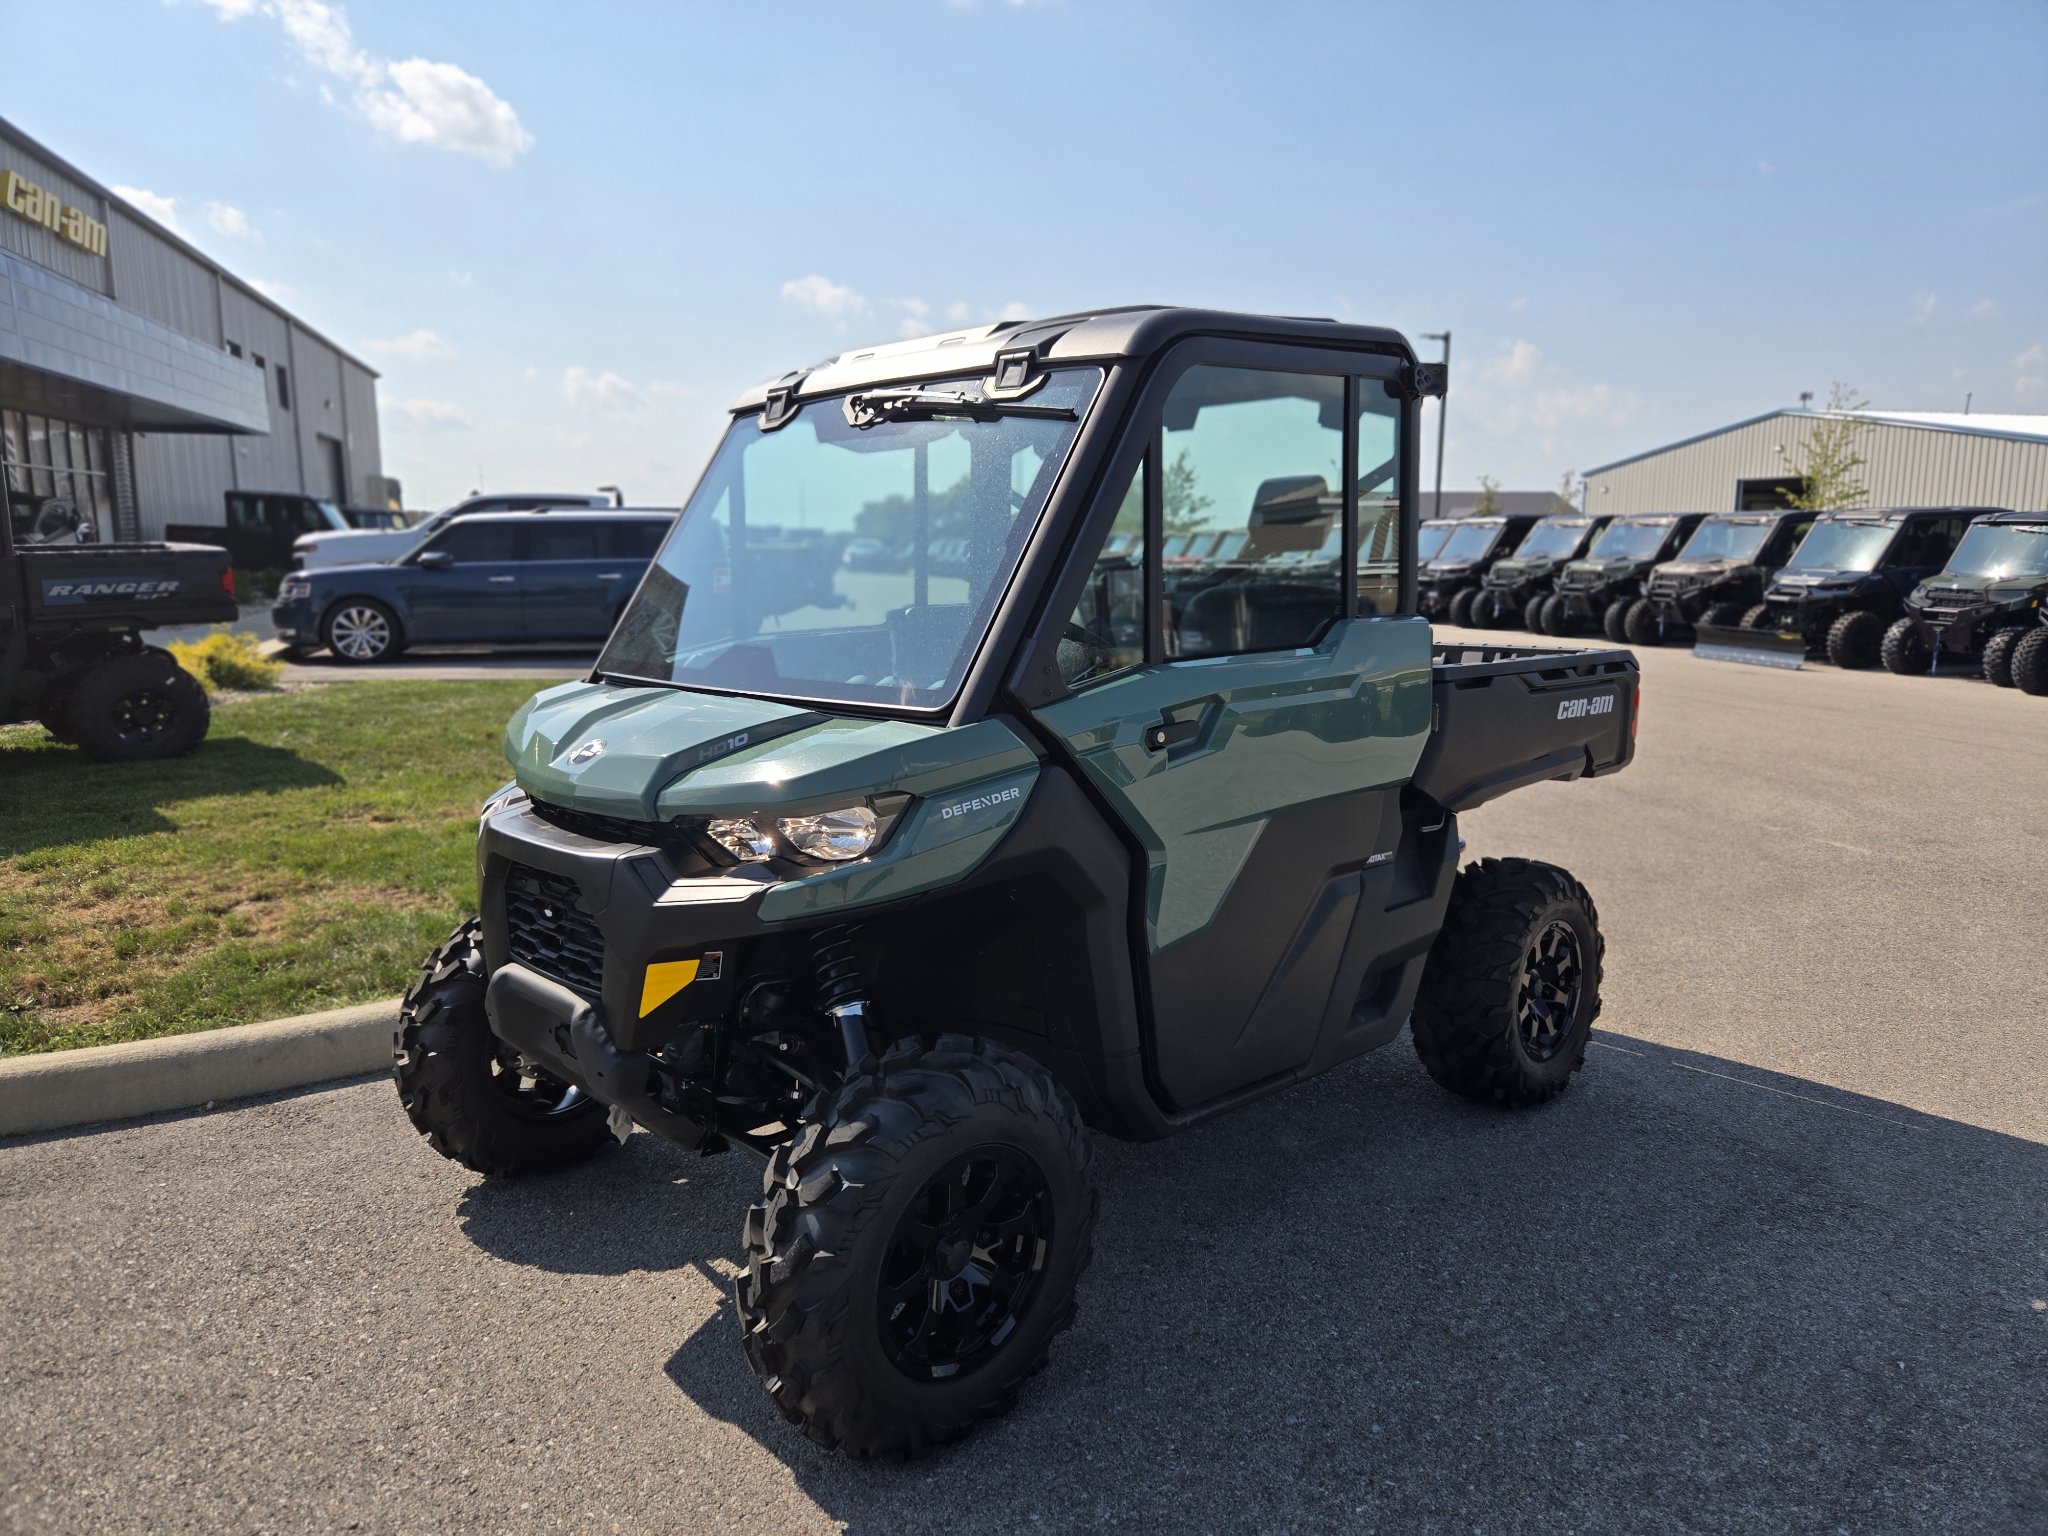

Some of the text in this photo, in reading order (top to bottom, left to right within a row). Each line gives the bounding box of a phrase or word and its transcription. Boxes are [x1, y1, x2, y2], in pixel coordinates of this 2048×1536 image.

[4, 168, 107, 257] can-am
[49, 581, 180, 597] RANGER
[1557, 694, 1614, 720] can-am
[699, 732, 749, 762] HD10
[941, 787, 1020, 820] DEFENDER
